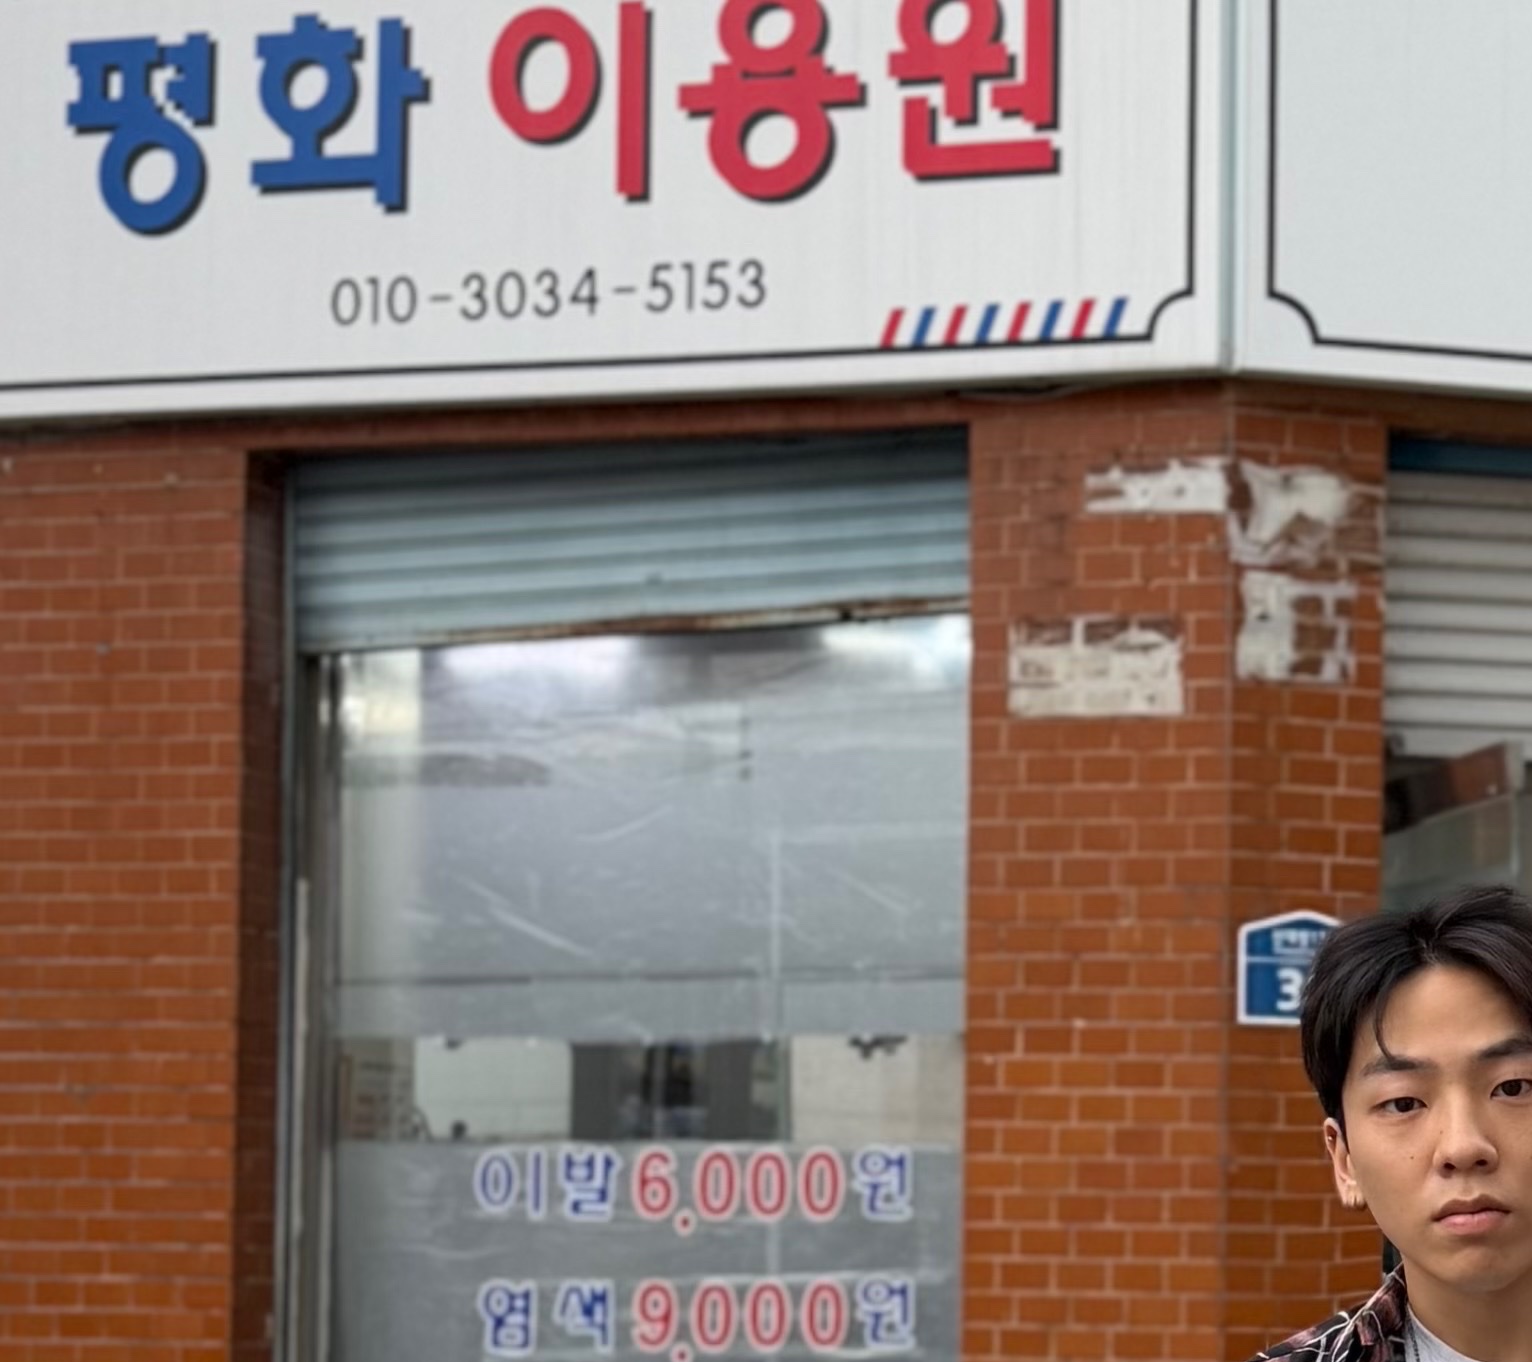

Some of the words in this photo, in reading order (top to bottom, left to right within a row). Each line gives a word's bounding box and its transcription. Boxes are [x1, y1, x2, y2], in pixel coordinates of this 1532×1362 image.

[66, 13, 430, 236] 평화
[488, 0, 1060, 202] 이용원
[330, 259, 767, 327] 010-3034-5153
[475, 1147, 620, 1220] 이발
[480, 1279, 615, 1355] 염색
